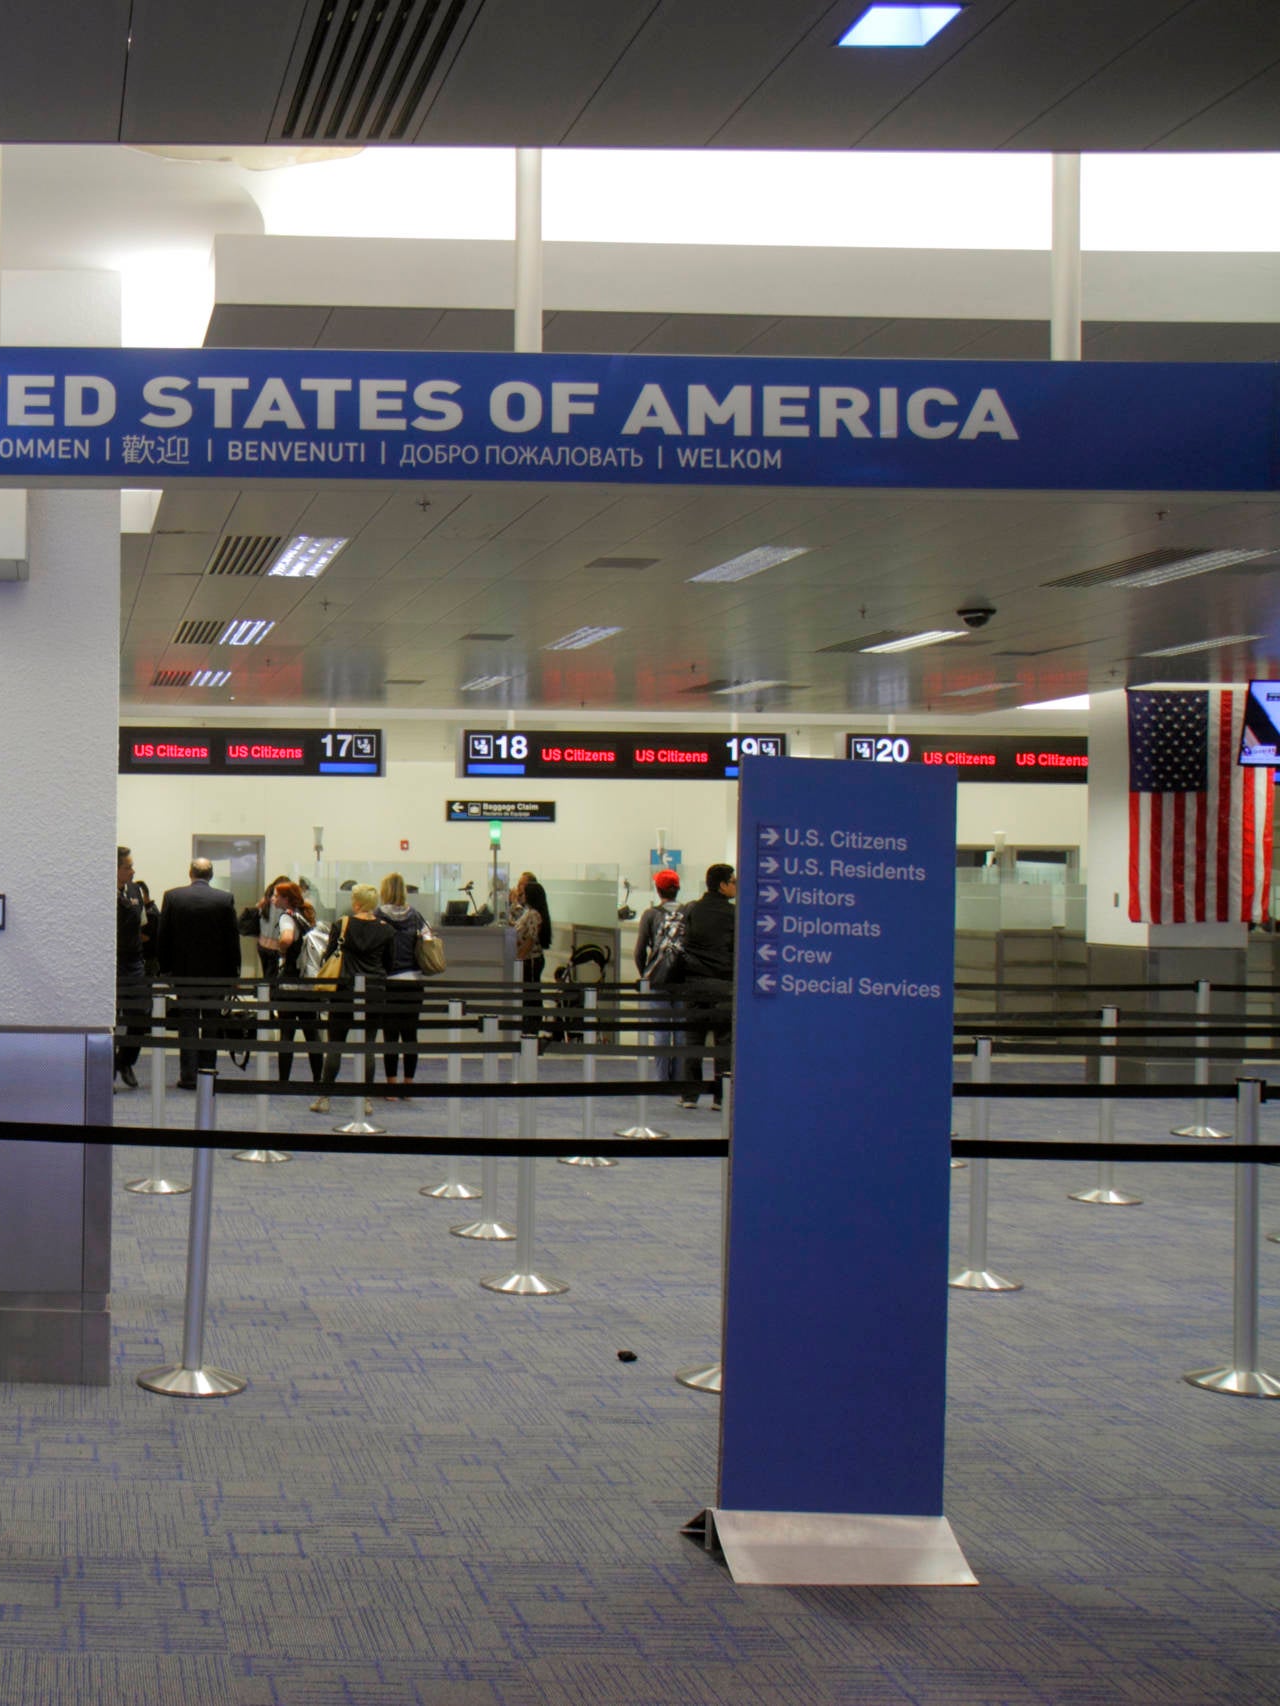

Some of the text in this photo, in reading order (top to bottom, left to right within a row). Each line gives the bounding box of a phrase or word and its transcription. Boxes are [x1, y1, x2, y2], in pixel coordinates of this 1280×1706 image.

[140, 376, 463, 432] STATES
[490, 380, 600, 433] OF
[621, 383, 1019, 440] AMERICA
[122, 435, 190, 464] 歡迎
[228, 440, 365, 463] BENVENUTI
[400, 443, 644, 468] ДОБРО ПОЖАЛОВАТЬ
[677, 448, 782, 470] WELKOM
[133, 744, 209, 759] US Citizens
[228, 745, 303, 760] US Citizens
[321, 734, 351, 758] 17
[495, 735, 528, 760] 18
[541, 748, 616, 763] US Citizens
[635, 749, 709, 764] US Citizens
[726, 737, 757, 761] 19
[876, 739, 910, 763] 20
[923, 751, 997, 766] US Citizens
[1015, 752, 1089, 768] US Citizens
[482, 802, 539, 811] Baggage Claim
[784, 828, 908, 851] U.S. Citizens
[784, 857, 926, 881] U.S. Residents
[782, 887, 856, 907] Visitors
[782, 916, 881, 938] Diplomats
[781, 945, 832, 964] Crew
[780, 974, 941, 998] Special Services
